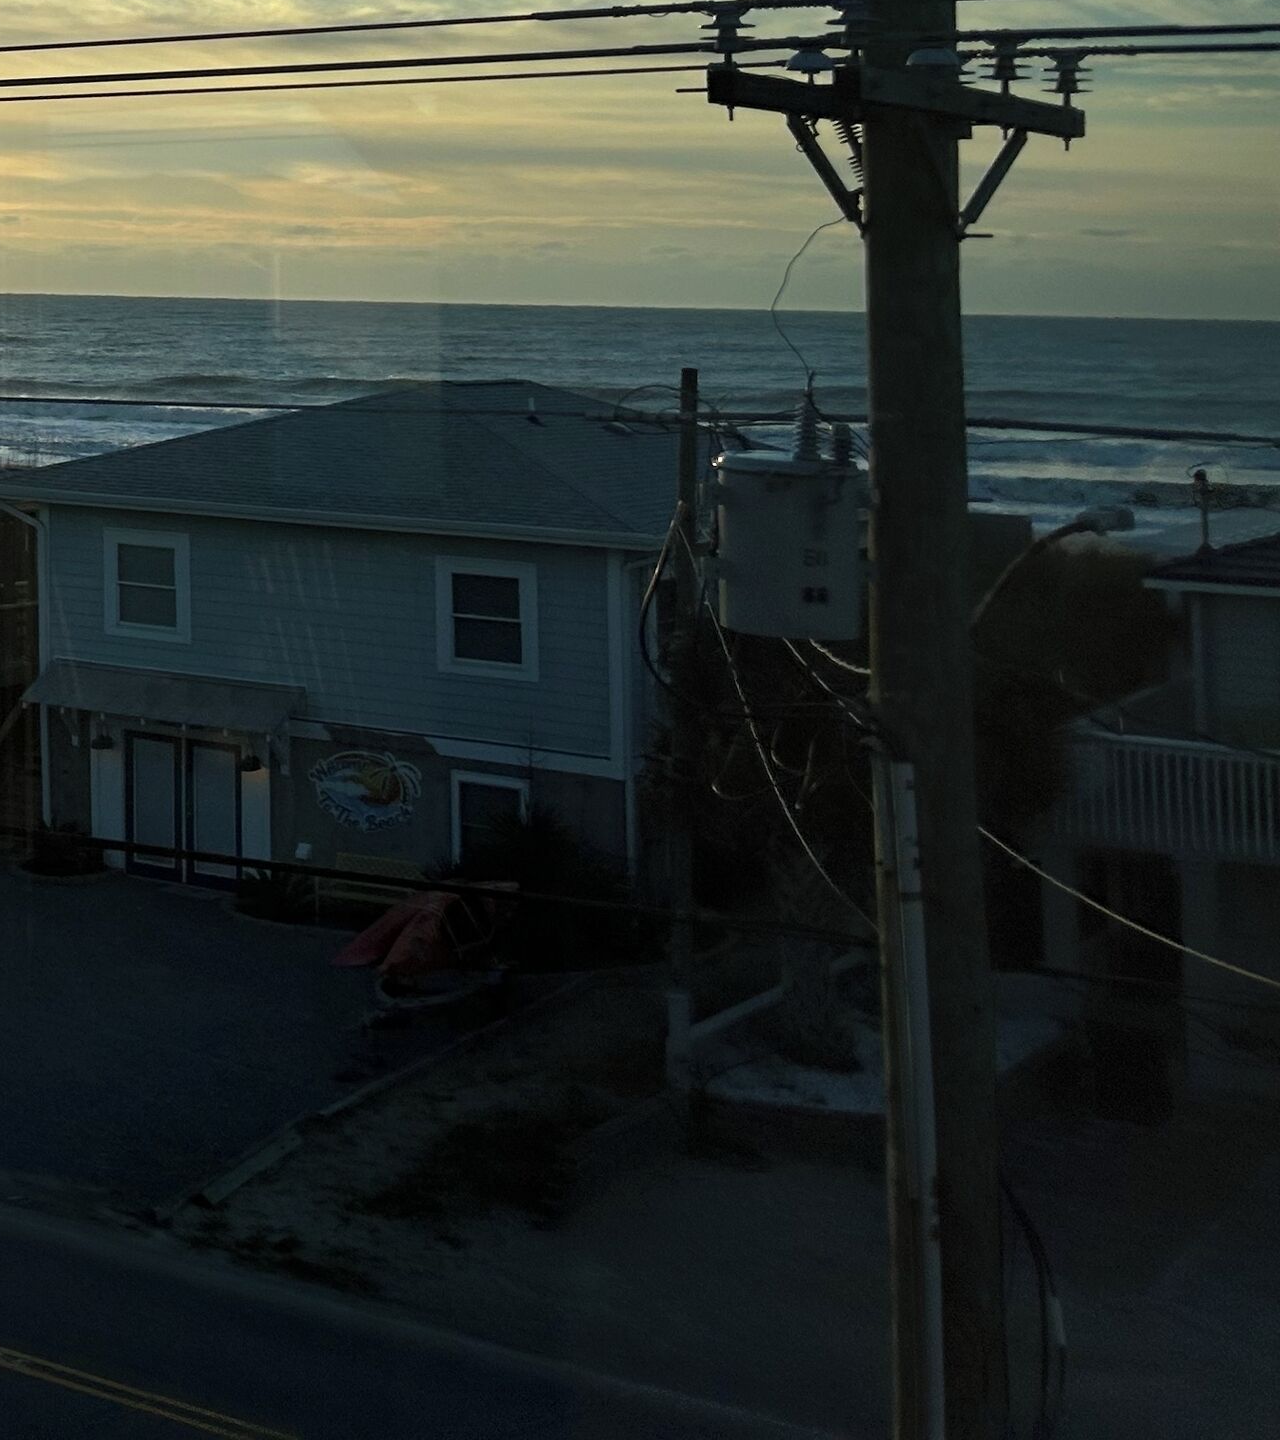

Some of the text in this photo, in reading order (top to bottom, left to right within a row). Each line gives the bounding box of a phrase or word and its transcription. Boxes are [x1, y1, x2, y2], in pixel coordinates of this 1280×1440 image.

[319, 790, 413, 831] To The Beach
